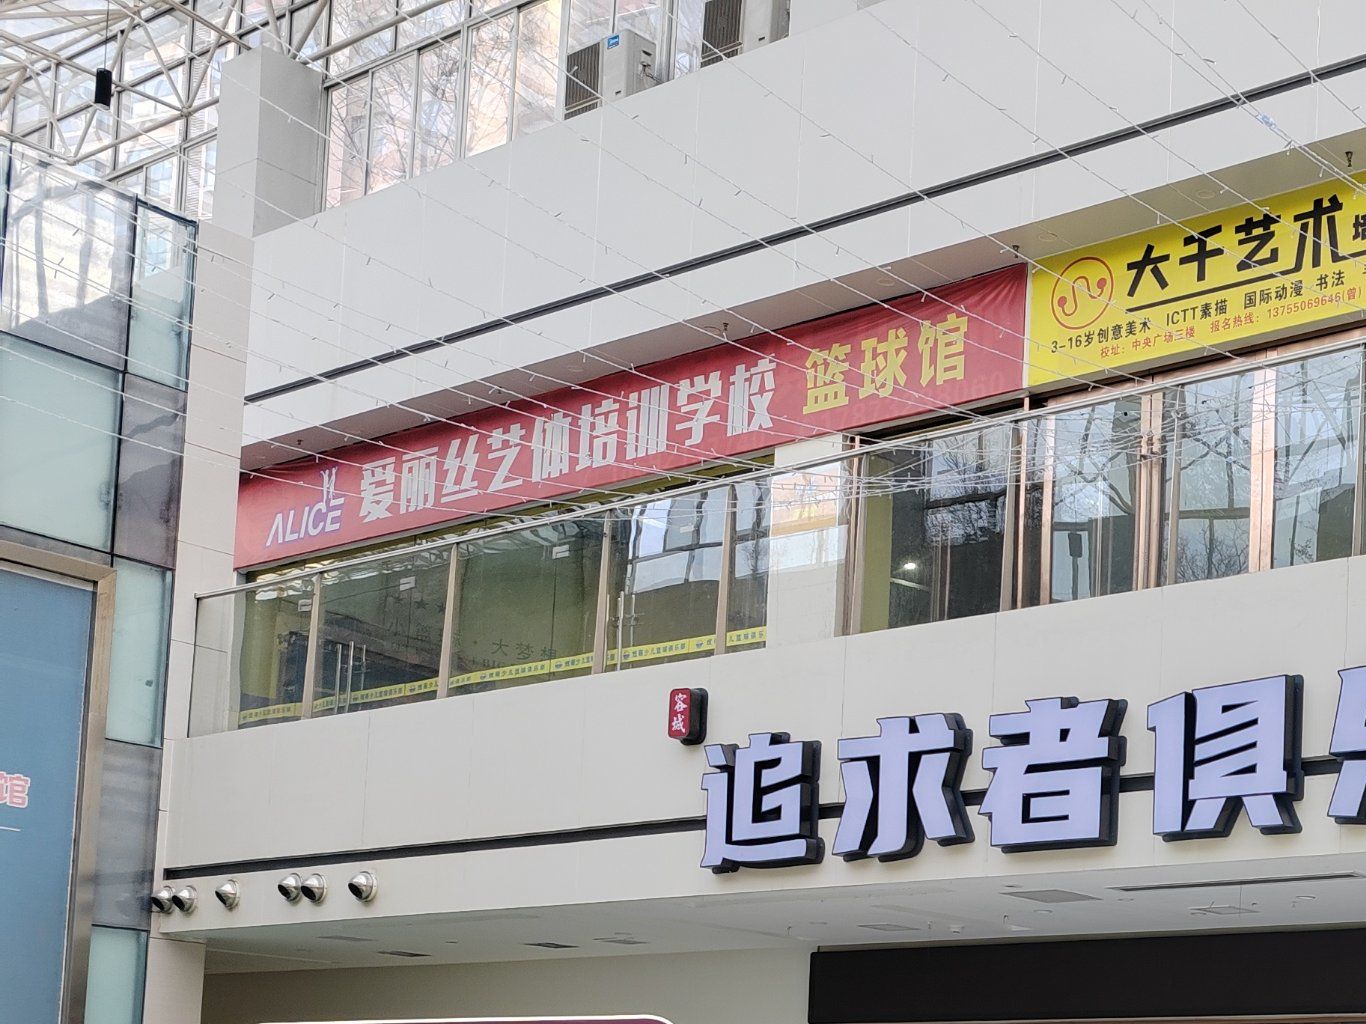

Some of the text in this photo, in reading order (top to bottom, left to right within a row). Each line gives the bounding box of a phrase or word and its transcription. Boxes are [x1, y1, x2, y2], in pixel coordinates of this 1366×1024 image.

[1126, 194, 1343, 298] 大千艺术
[1051, 317, 1152, 353] 3-16岁创意美术
[1166, 298, 1228, 326] ICTT素描
[1244, 280, 1303, 309] 国际动漫
[1316, 269, 1345, 291] 书法
[359, 355, 776, 523] 爱丽丝艺体培训学校
[802, 314, 969, 416] 篮球馆
